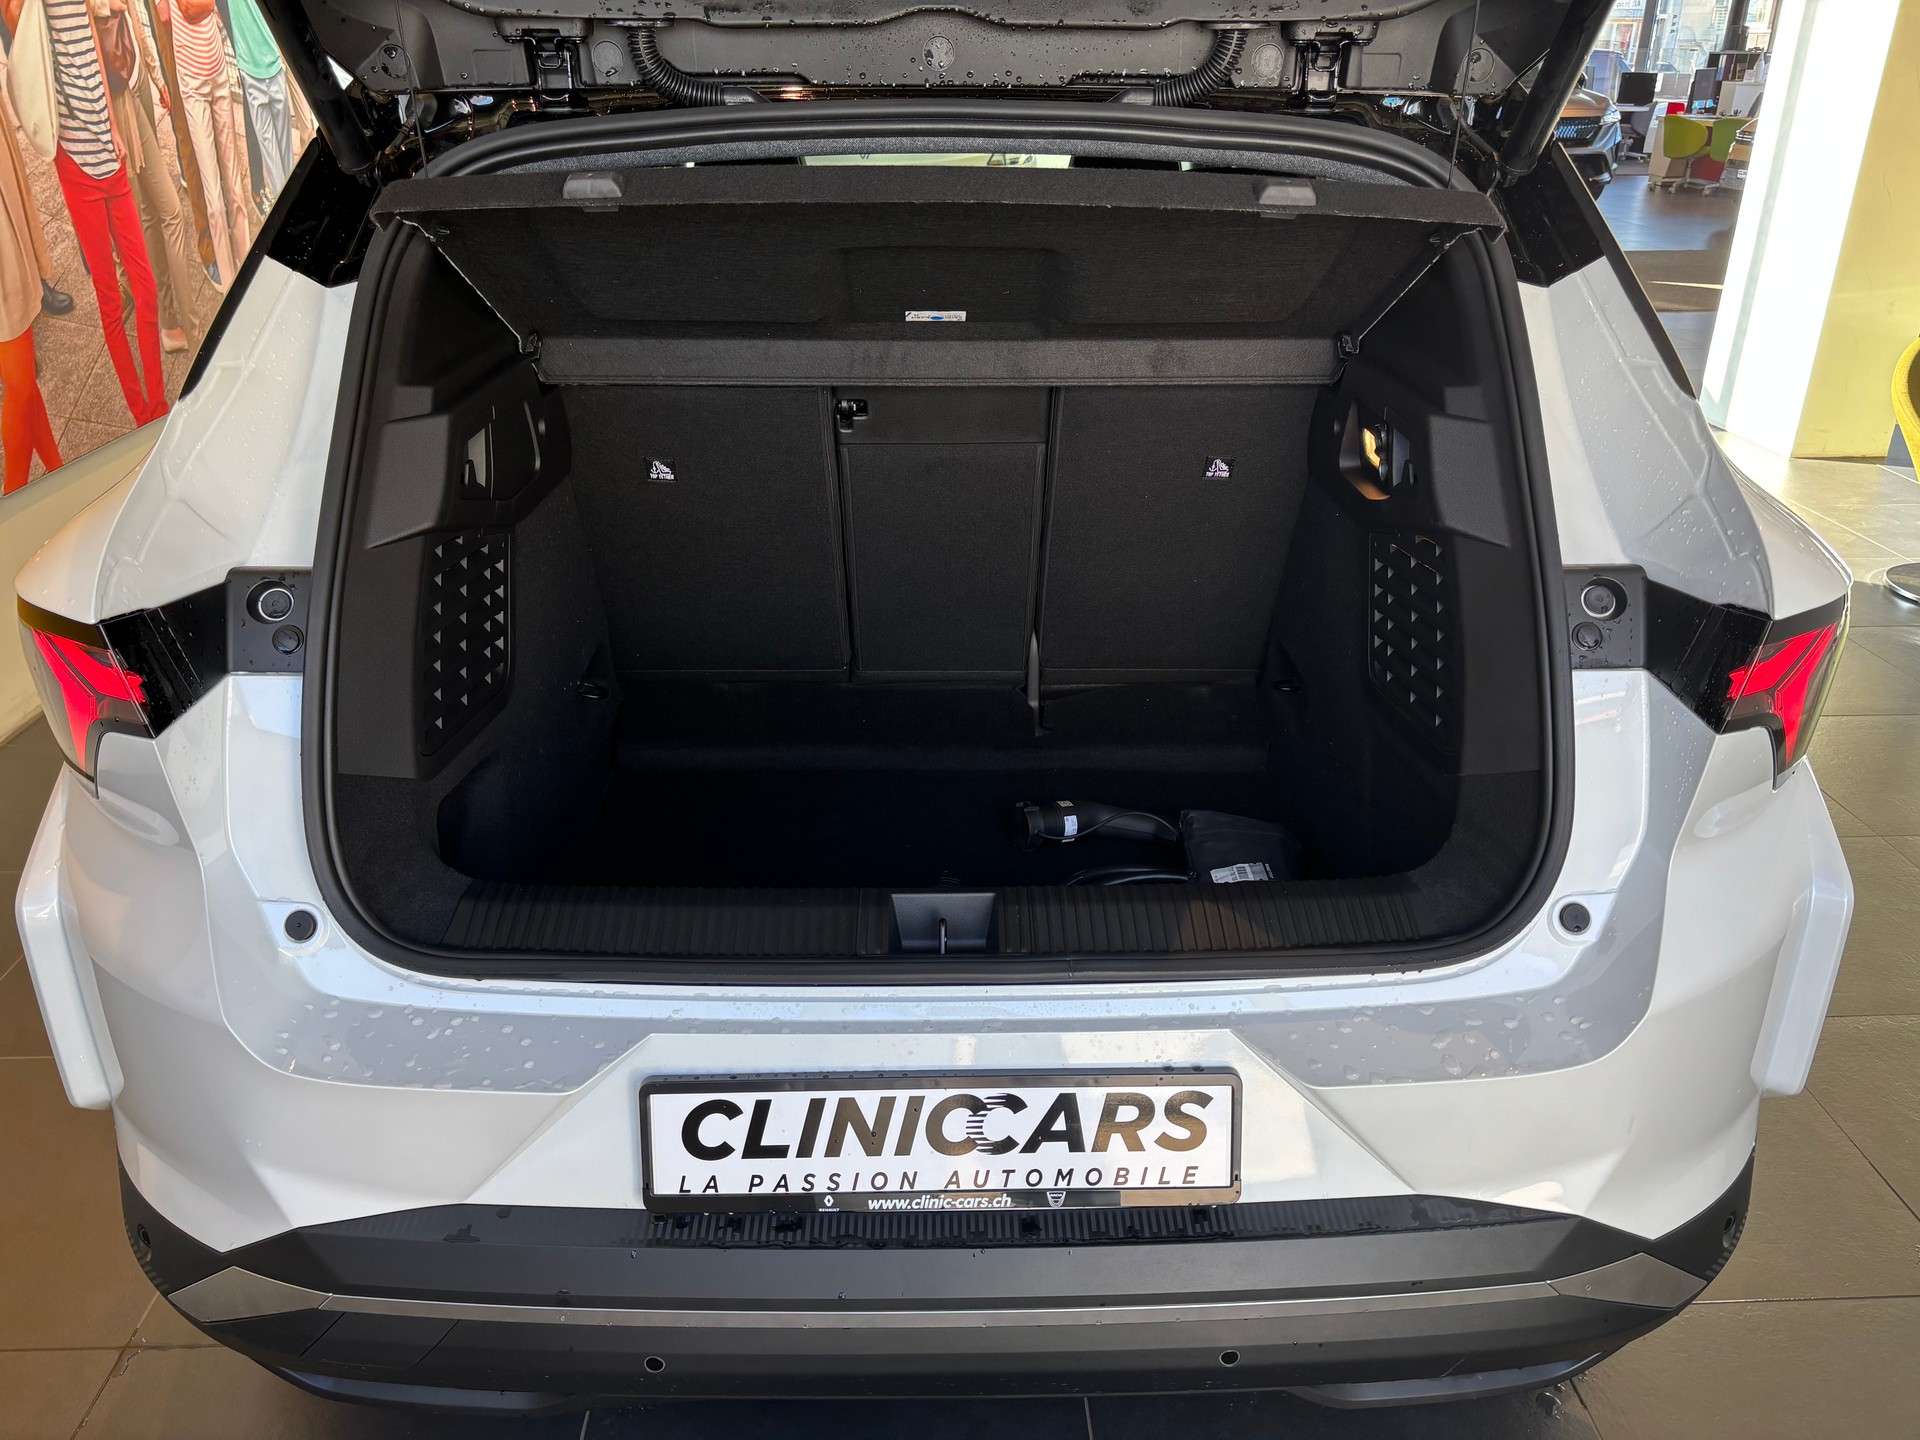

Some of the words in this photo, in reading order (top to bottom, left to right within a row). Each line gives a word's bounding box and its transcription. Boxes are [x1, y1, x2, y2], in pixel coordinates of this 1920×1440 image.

[679, 1175, 719, 1193] LA
[748, 1171, 918, 1193] PASSION
[944, 1165, 1199, 1189] AUTOMOBILE
[868, 1194, 1012, 1210] www.clinic-cars.ch
